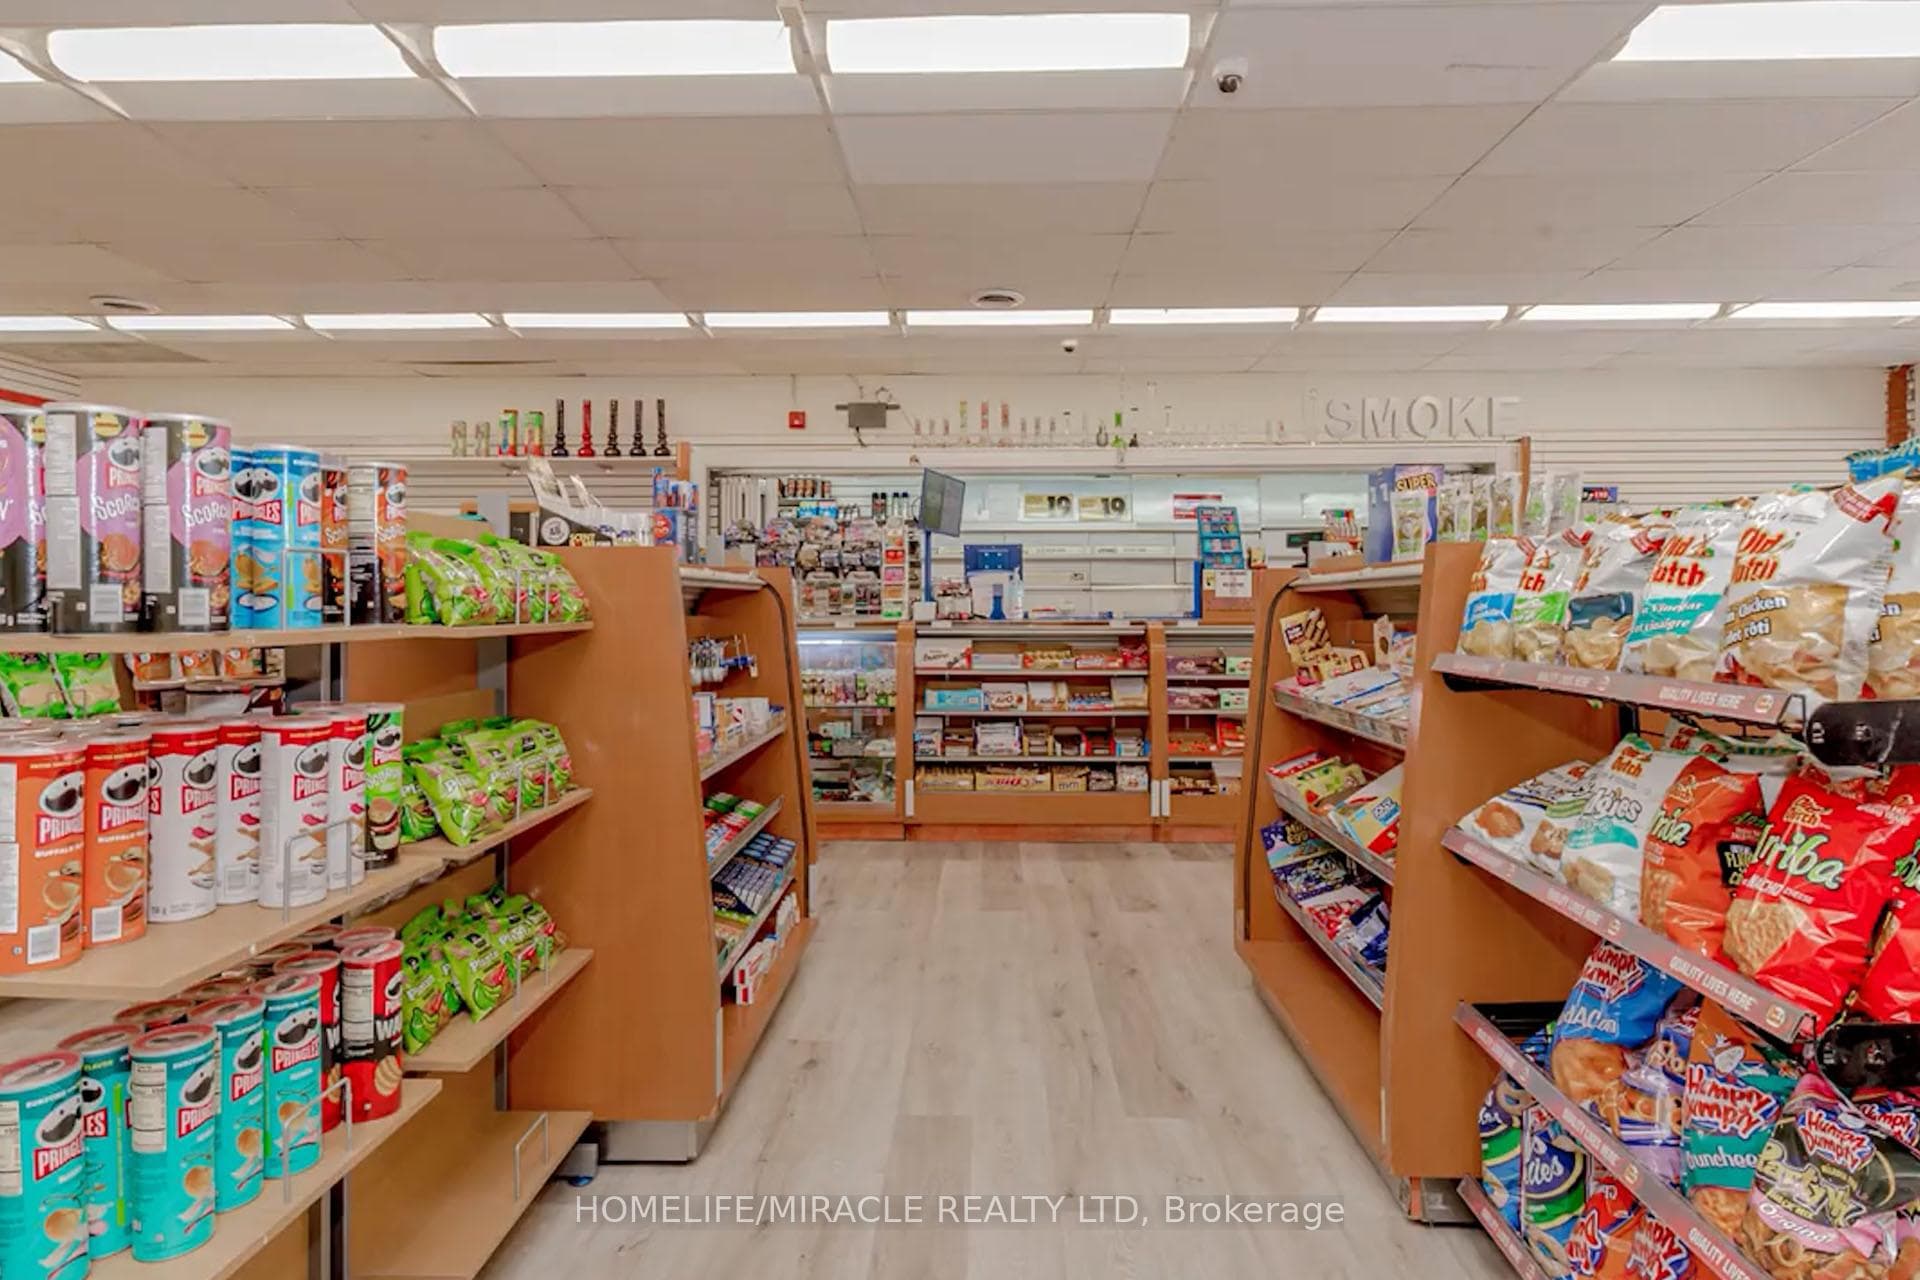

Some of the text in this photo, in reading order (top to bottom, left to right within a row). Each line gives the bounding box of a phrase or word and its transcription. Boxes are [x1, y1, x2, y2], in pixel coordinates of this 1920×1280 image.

[1324, 396, 1521, 438] SMOKE
[1047, 495, 1072, 514] 19
[1101, 497, 1126, 515] 19
